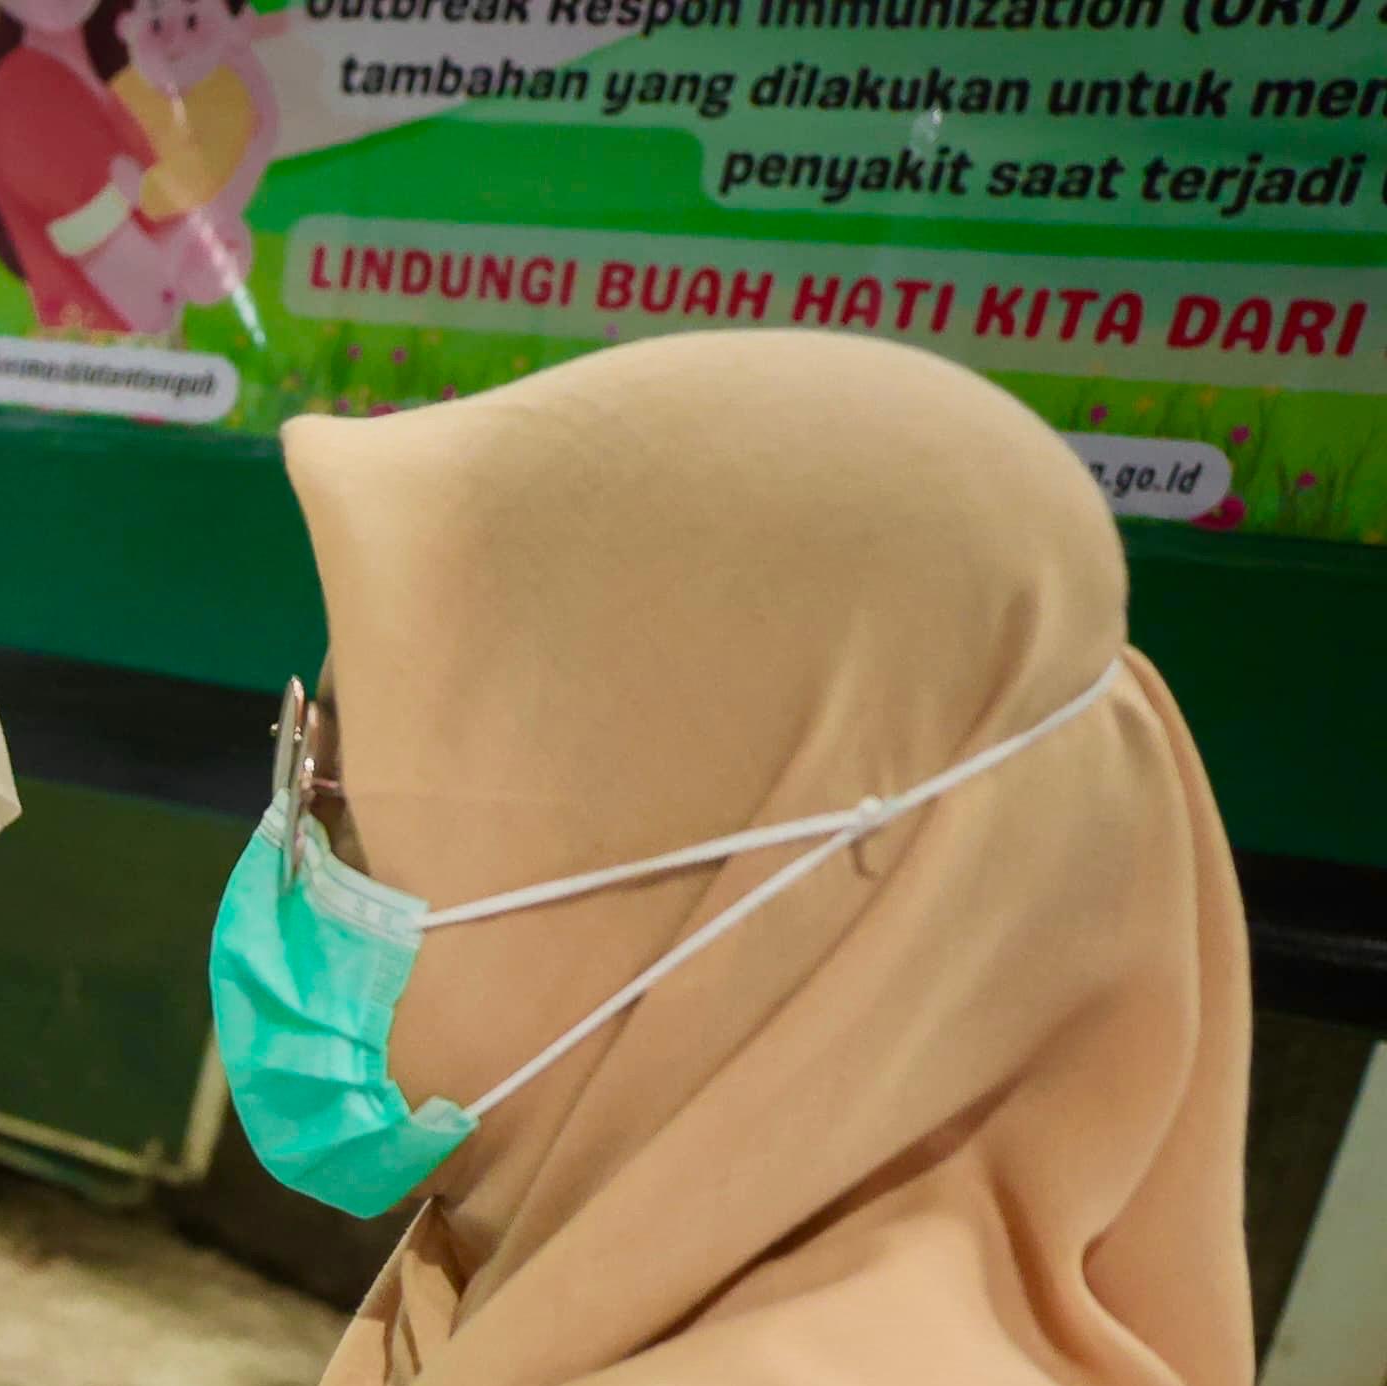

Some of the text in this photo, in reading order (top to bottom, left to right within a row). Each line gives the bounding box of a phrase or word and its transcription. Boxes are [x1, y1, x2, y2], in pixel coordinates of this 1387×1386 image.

[548, 0, 740, 38] Respon
[757, 0, 1166, 30] Immunization
[340, 53, 591, 102] tambahan
[600, 66, 737, 119] yang
[749, 62, 1031, 115] dilakukan
[1048, 68, 1233, 118] untuk
[719, 146, 1368, 218] penyakit saat terjadi
[310, 246, 1369, 359] LINDUNGI BUAH HATI KITA DARI
